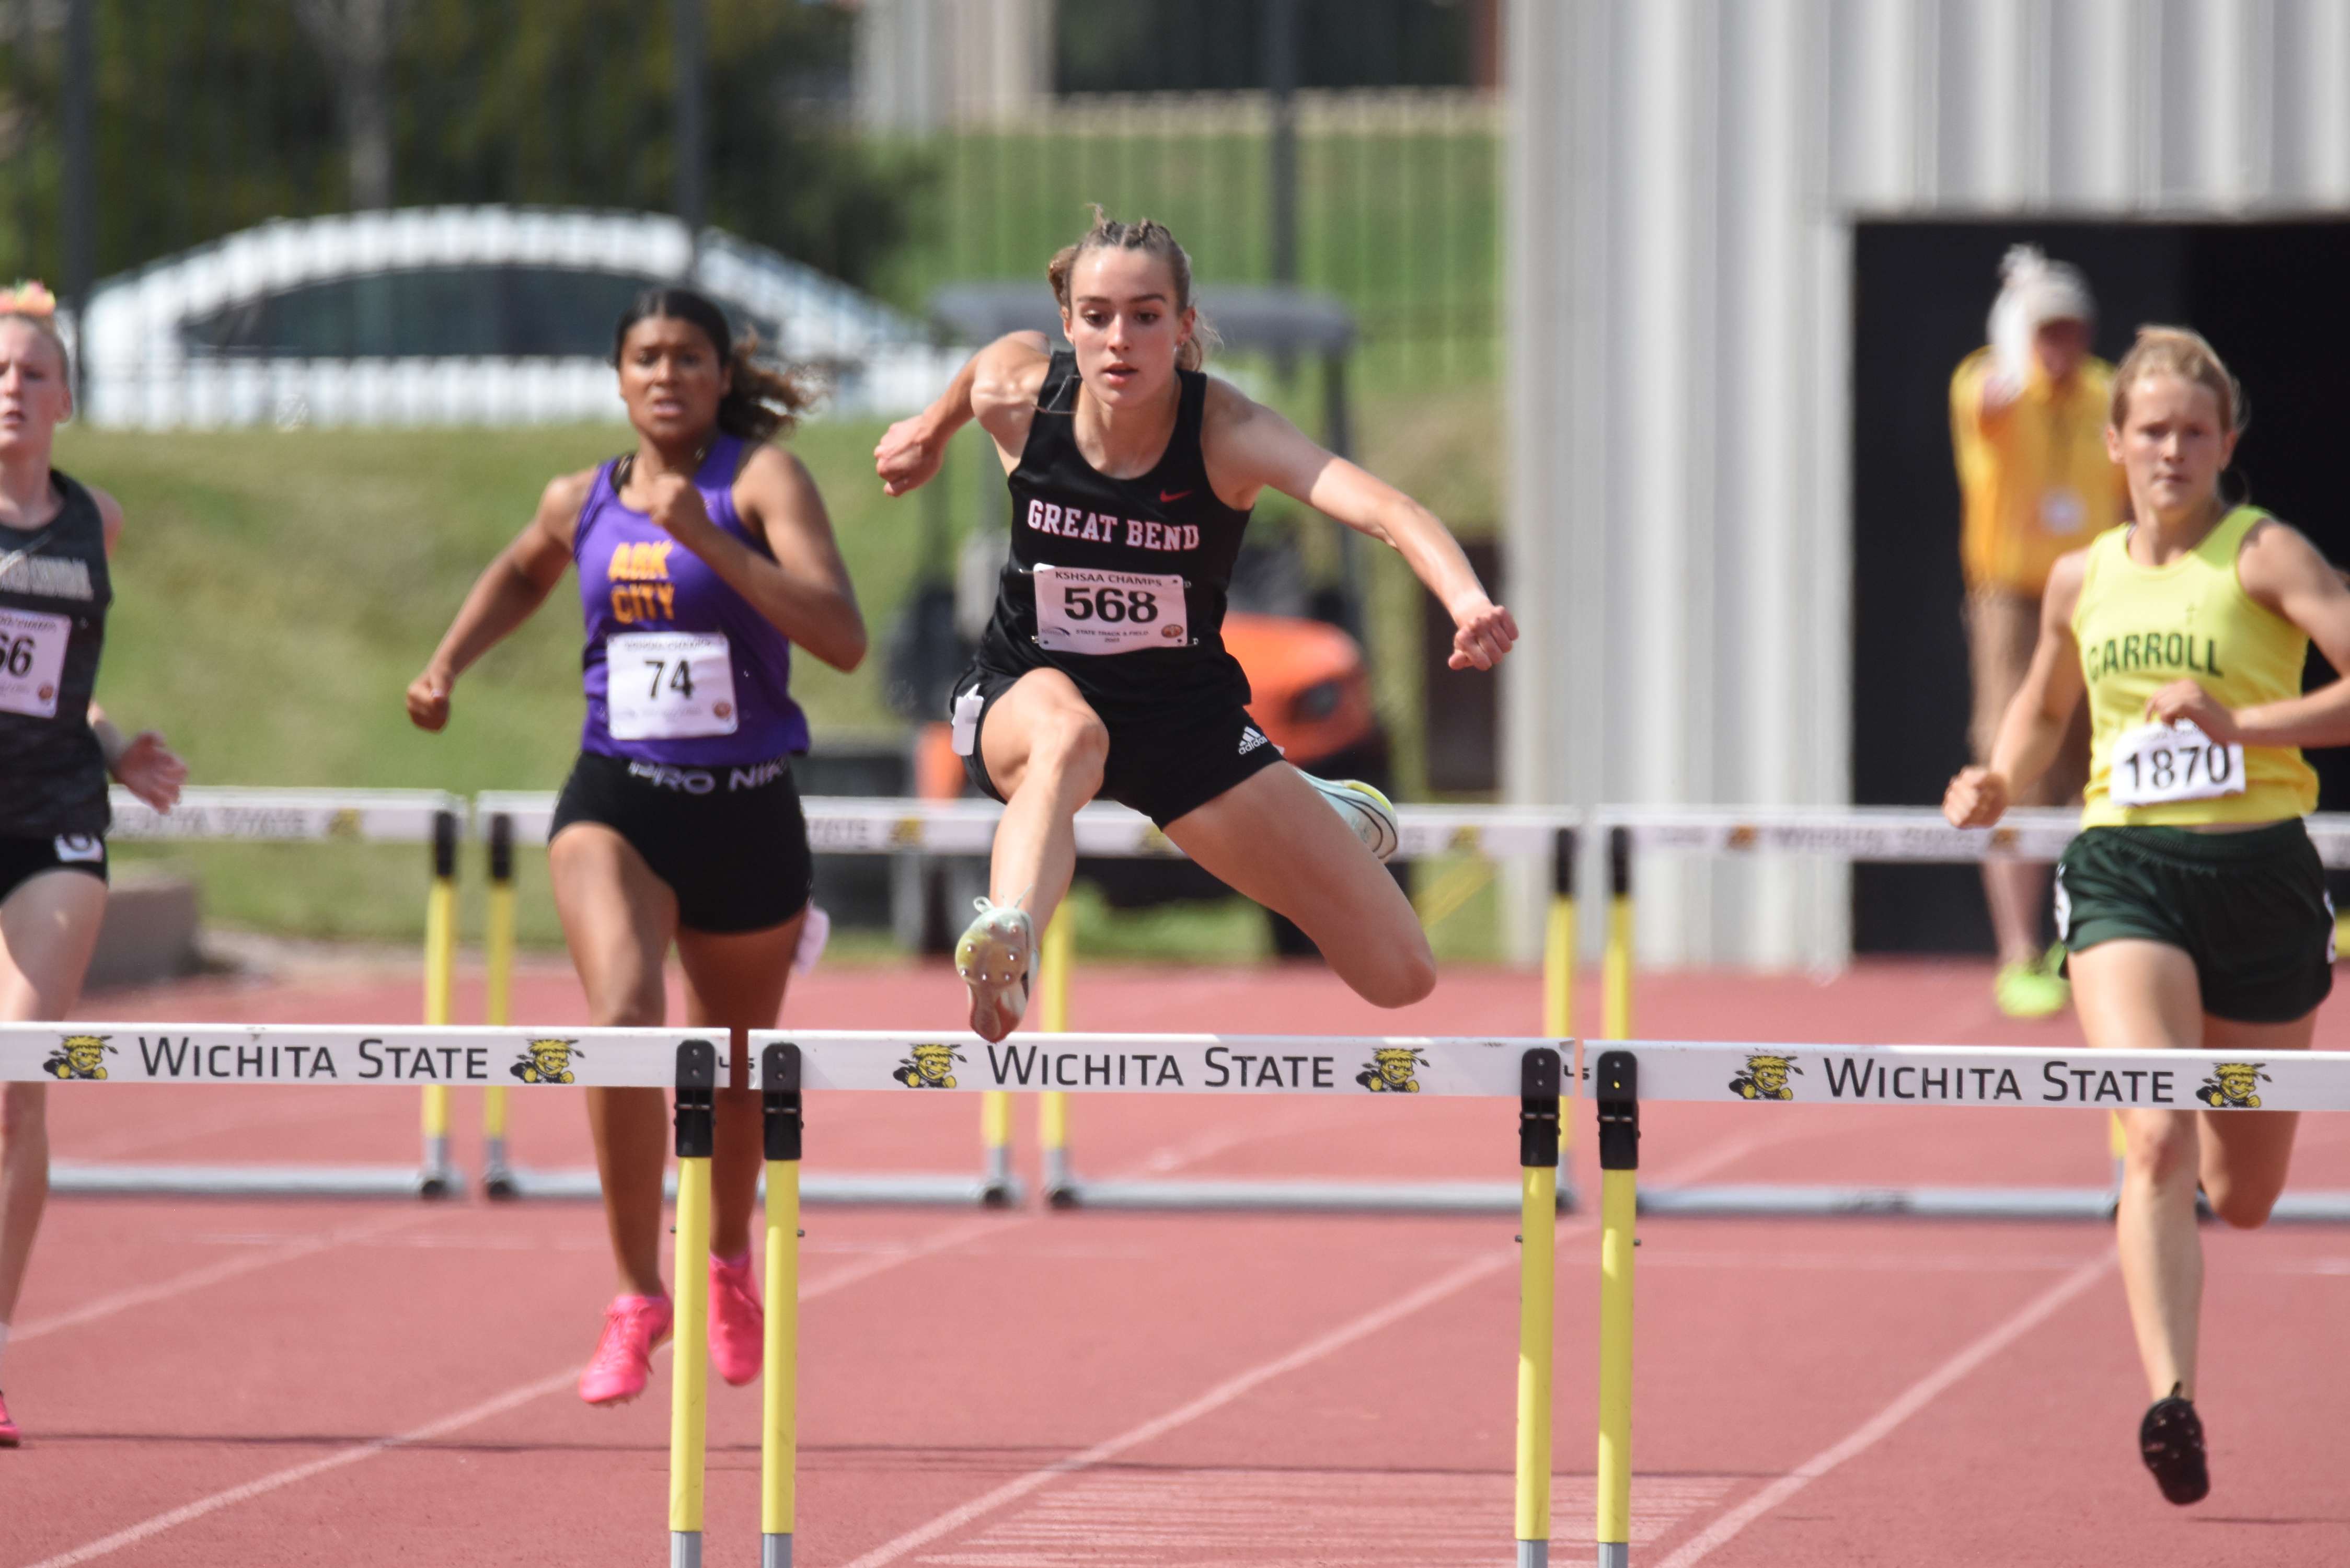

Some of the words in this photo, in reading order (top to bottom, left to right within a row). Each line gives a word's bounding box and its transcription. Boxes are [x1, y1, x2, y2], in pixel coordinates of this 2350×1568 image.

[1028, 499, 1118, 543] GREAT
[1125, 519, 1200, 550] BEND
[1055, 571, 1105, 583] KSHSAA
[1108, 574, 1162, 586] CHAMPS
[612, 583, 675, 624] CITY
[1064, 587, 1158, 623] 568
[643, 659, 694, 698] 74
[2088, 632, 2225, 683] CARROLL
[1238, 735, 1268, 755] adidas
[2124, 742, 2230, 791] 1870
[139, 1036, 337, 1078] WICHITA
[358, 1039, 488, 1079] STATE
[987, 1045, 1184, 1086] WICHITA
[1204, 1047, 1334, 1088] STATE
[1824, 1058, 2022, 1100] WICHITA
[2042, 1061, 2173, 1103] STATE
